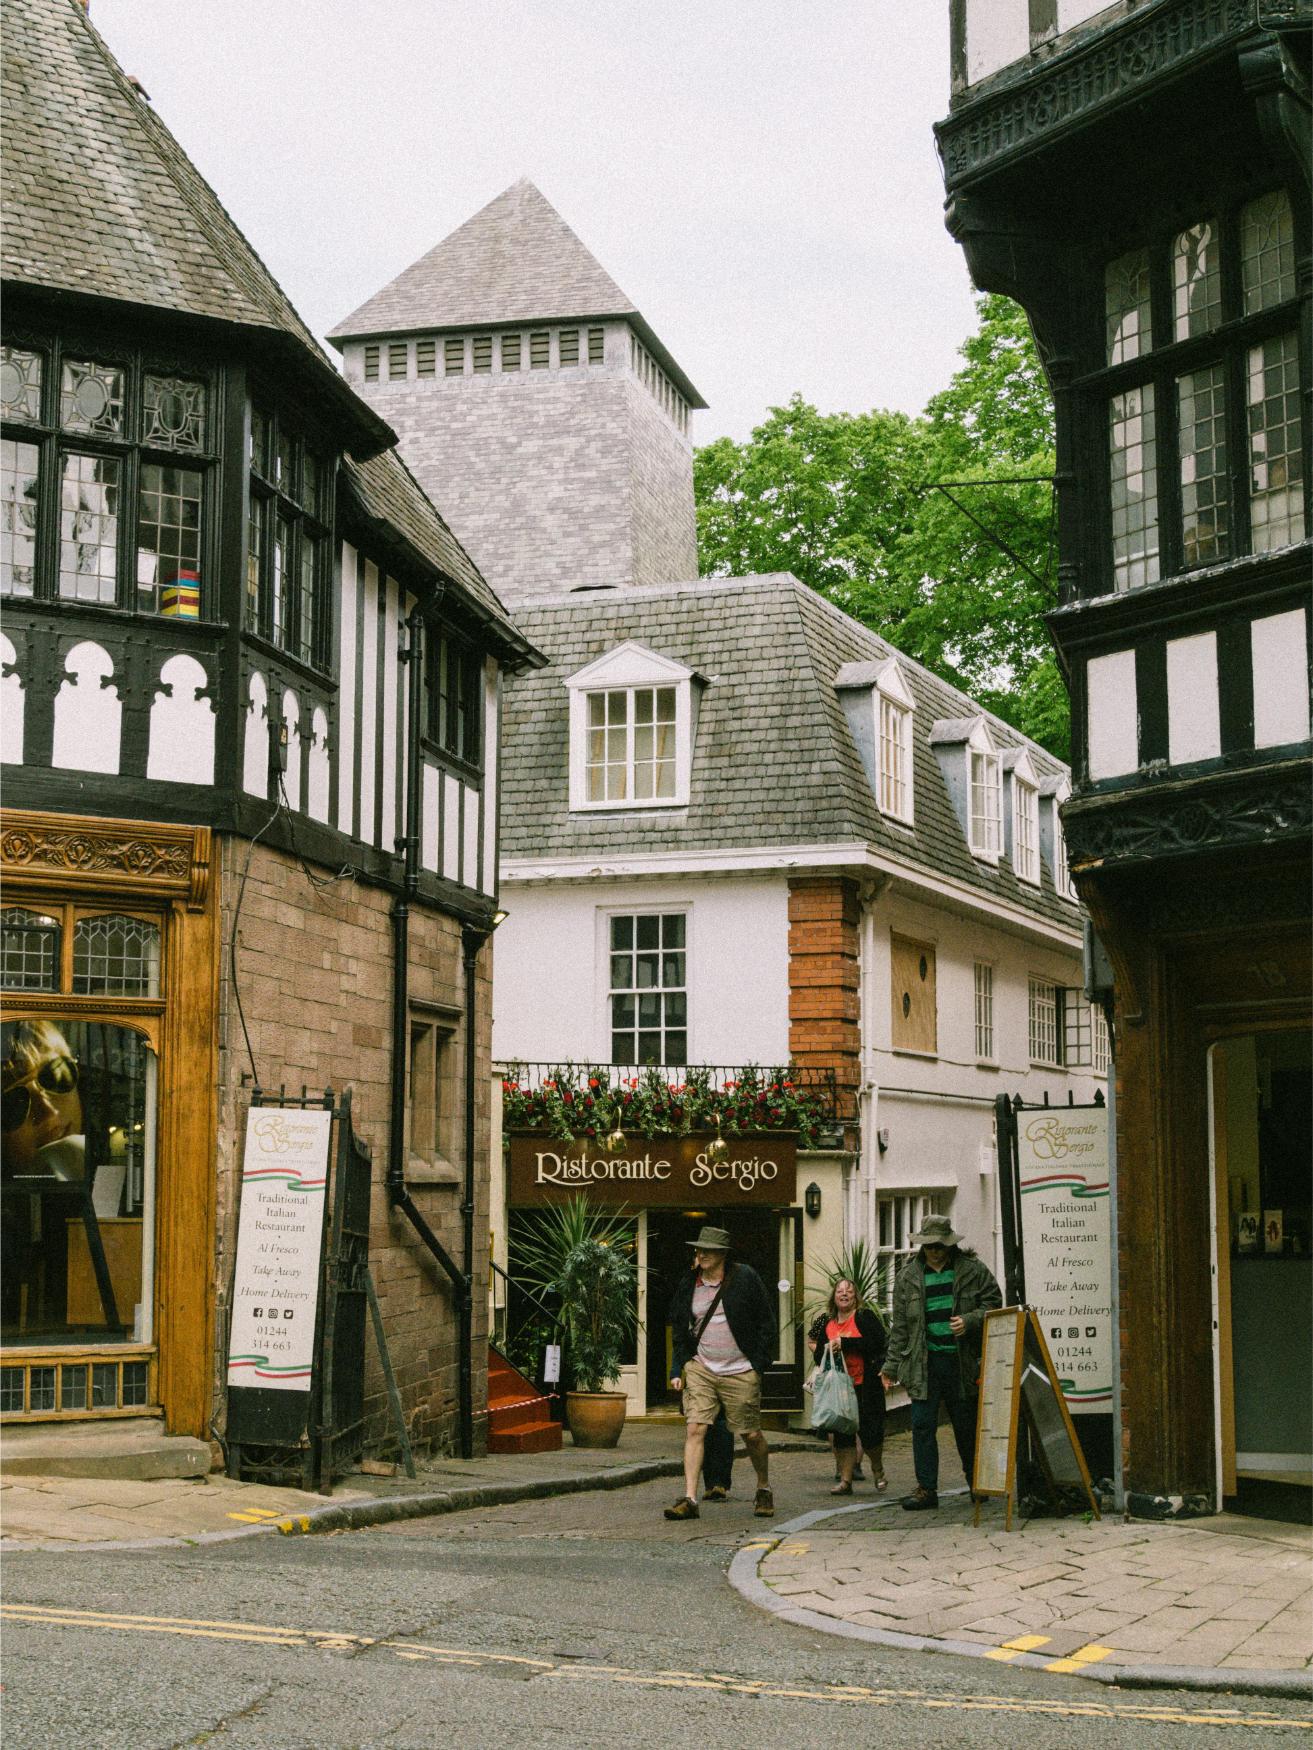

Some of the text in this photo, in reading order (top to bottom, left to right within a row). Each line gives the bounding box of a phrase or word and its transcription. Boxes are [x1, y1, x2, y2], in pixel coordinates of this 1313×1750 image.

[1025, 1117, 1098, 1142] Ristorante
[1032, 1136, 1095, 1159] Sergio
[534, 1152, 778, 1190] Ristorante Sergio
[256, 1193, 308, 1205] Traditional
[266, 1207, 296, 1218] Italian
[1038, 1201, 1097, 1213] Traditional
[255, 1220, 305, 1232] Restaurant
[1052, 1217, 1085, 1228] Italian
[1041, 1233, 1098, 1243] Restaurant
[257, 1243, 299, 1254] Al Fresco
[1047, 1256, 1094, 1268] Al Fresco
[253, 1265, 302, 1277] Take Away
[1044, 1281, 1099, 1292] Take Away
[240, 1286, 310, 1300] Home Delivery
[1034, 1305, 1112, 1317] Home Delivery
[257, 1326, 287, 1336] 01244
[251, 1339, 291, 1351] 314 663
[1057, 1346, 1092, 1357] 01244
[1078, 1361, 1098, 1372] 663
